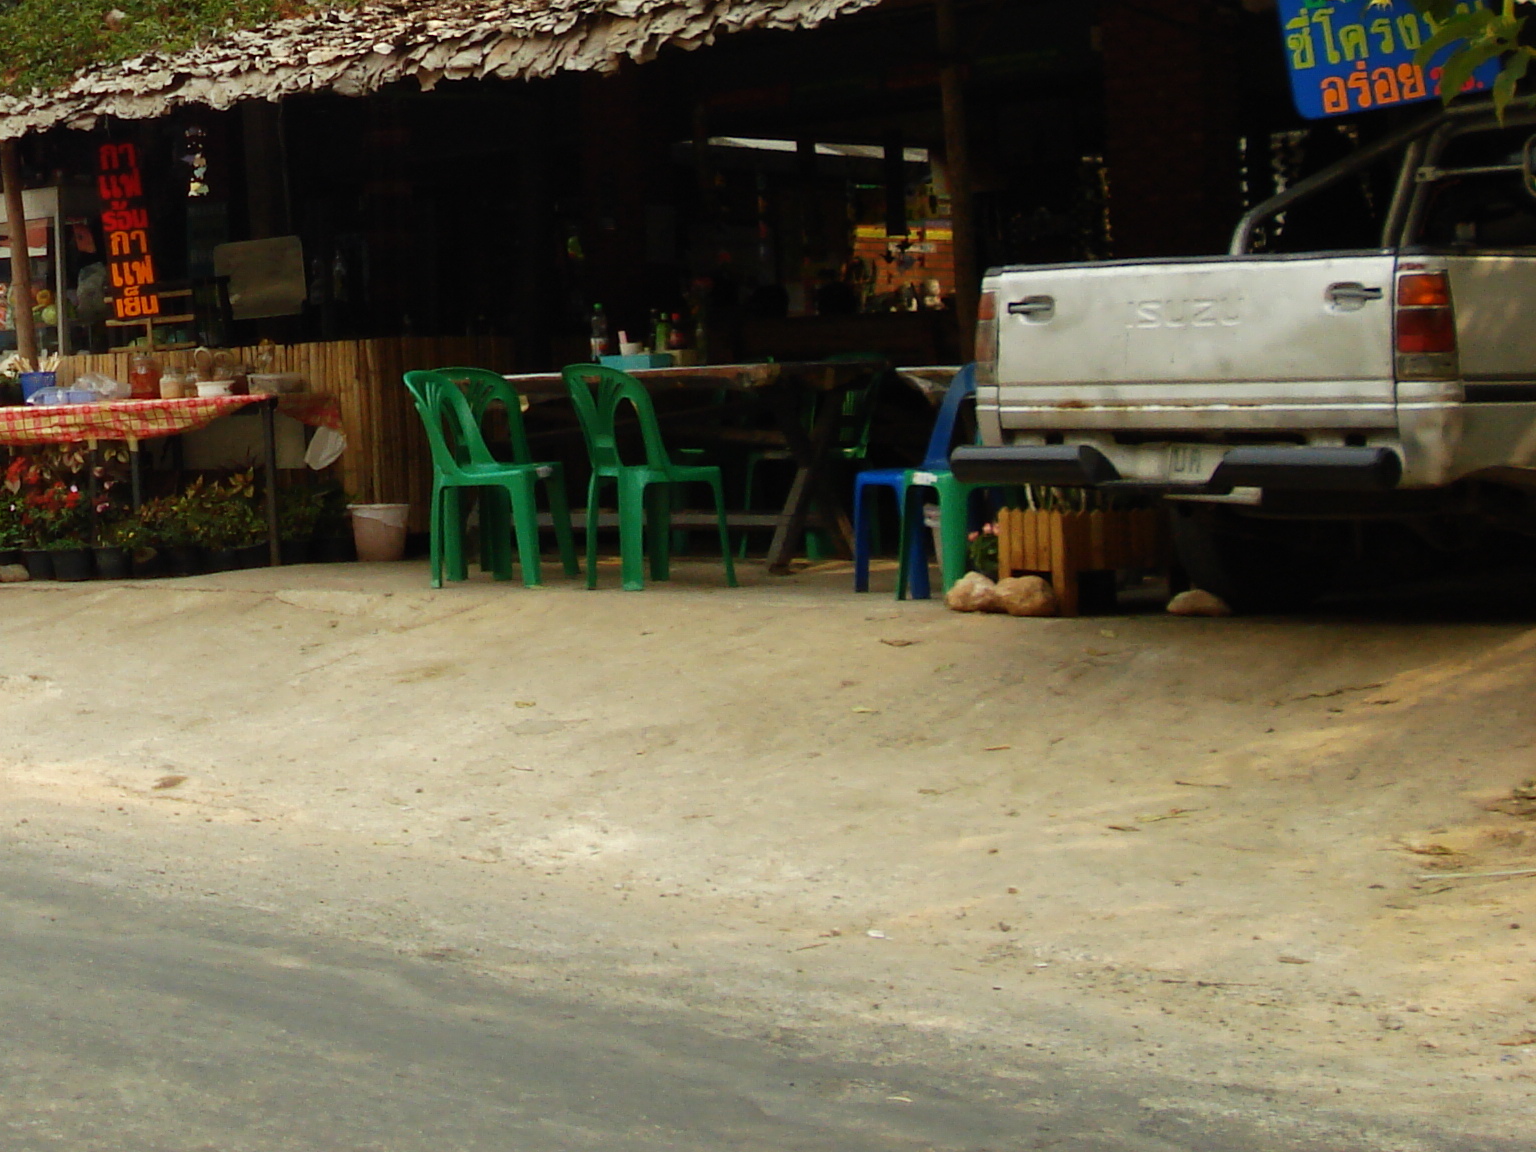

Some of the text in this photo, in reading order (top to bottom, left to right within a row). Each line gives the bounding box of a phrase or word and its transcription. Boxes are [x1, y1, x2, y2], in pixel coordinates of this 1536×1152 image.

[1320, 60, 1427, 114] อร่อย
[99, 143, 136, 170] กา
[110, 230, 147, 255] กา
[111, 255, 154, 288] แฟ
[115, 285, 160, 318] เย็น
[1126, 297, 1244, 329] ISUZU
